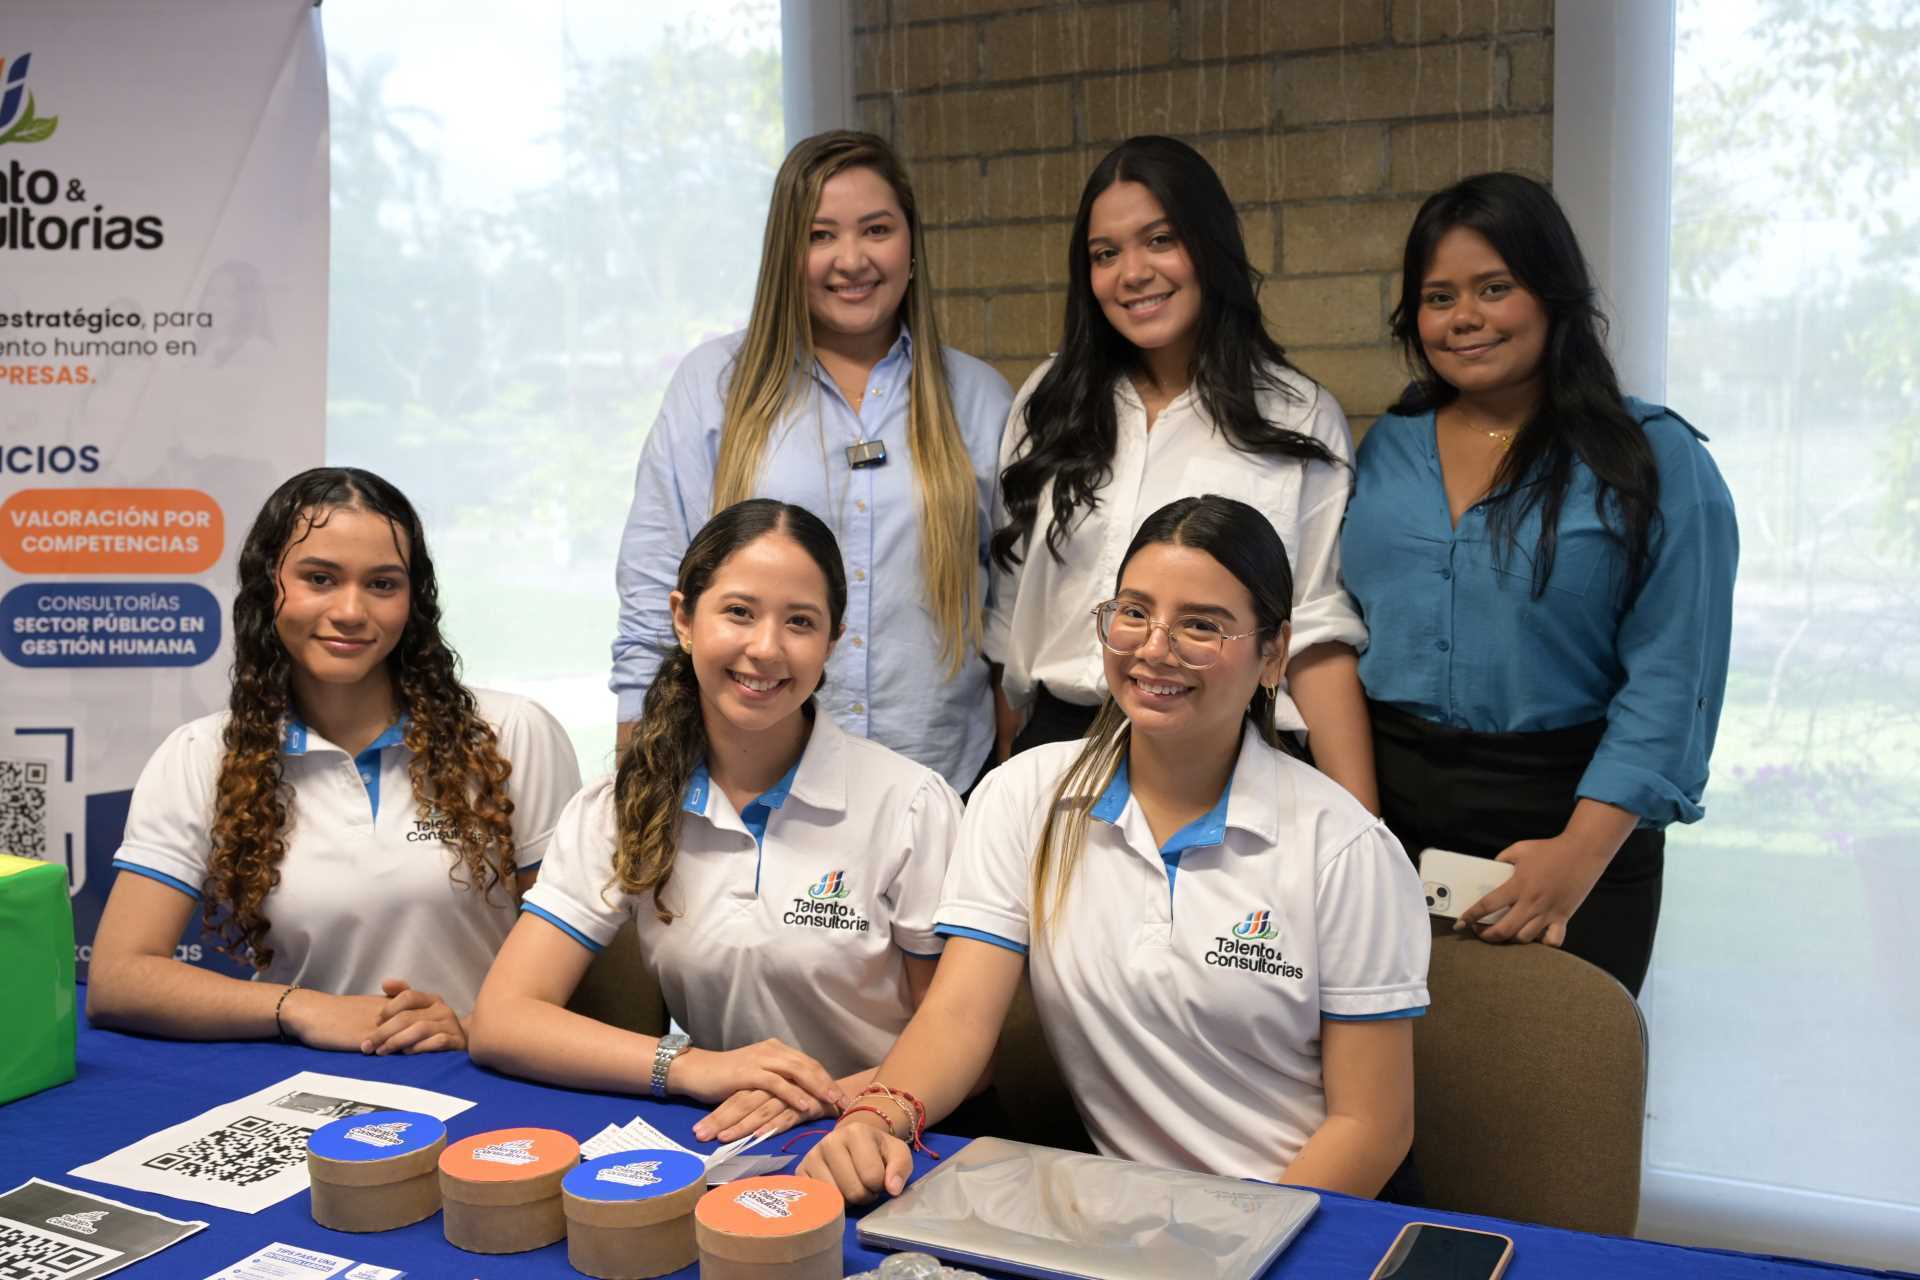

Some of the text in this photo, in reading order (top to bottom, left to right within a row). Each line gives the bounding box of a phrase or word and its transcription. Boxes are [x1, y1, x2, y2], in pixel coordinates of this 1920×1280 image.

[66, 178, 86, 202] &
[153, 311, 213, 333] para
[54, 337, 158, 356] humano
[165, 339, 197, 356] en
[11, 506, 210, 528] VALORACIÓN POR
[21, 535, 199, 553] COMPETENCIAS
[38, 593, 181, 611] CONSULTORÍAS
[13, 613, 205, 633] SECTOR PÚBLICO EN
[21, 635, 196, 655] GESTIÓN HUMANA
[793, 898, 848, 916] Talento
[1215, 936, 1275, 960] Talento
